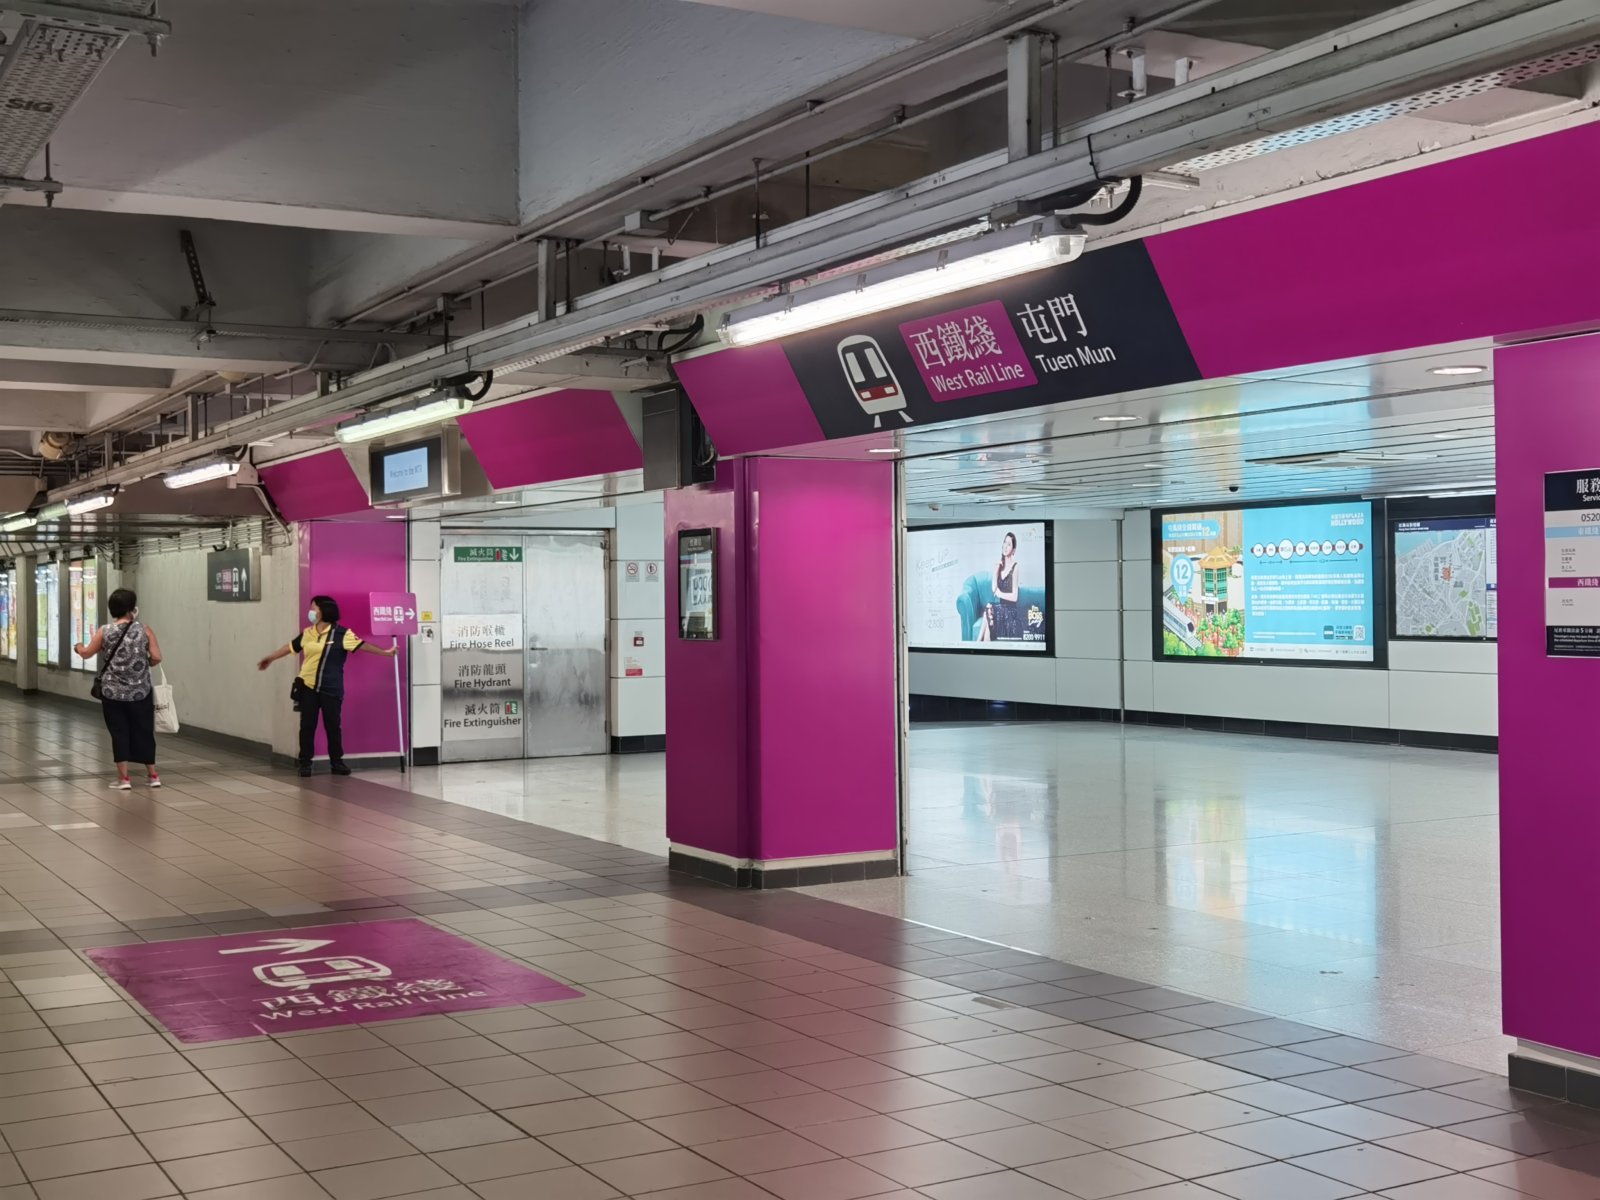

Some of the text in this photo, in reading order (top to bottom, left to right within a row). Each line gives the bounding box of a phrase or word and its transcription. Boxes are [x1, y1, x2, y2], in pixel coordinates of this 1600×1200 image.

[1016, 293, 1088, 345] 屯門
[908, 315, 1003, 369] 西鐵綫
[1035, 344, 1117, 375] Tuen Mun
[931, 362, 1025, 394] West Rail Line
[1330, 518, 1364, 527] HOLLYWOOD
[1176, 564, 1189, 580] 12
[450, 638, 514, 650] Fire Hose Reel
[458, 663, 507, 677] 消防龍頭
[454, 678, 511, 690] Fire Hydrant
[464, 703, 500, 716] 滅火筒
[444, 717, 522, 730] Fire Extinguisher
[258, 989, 488, 1020] West Rail Line
